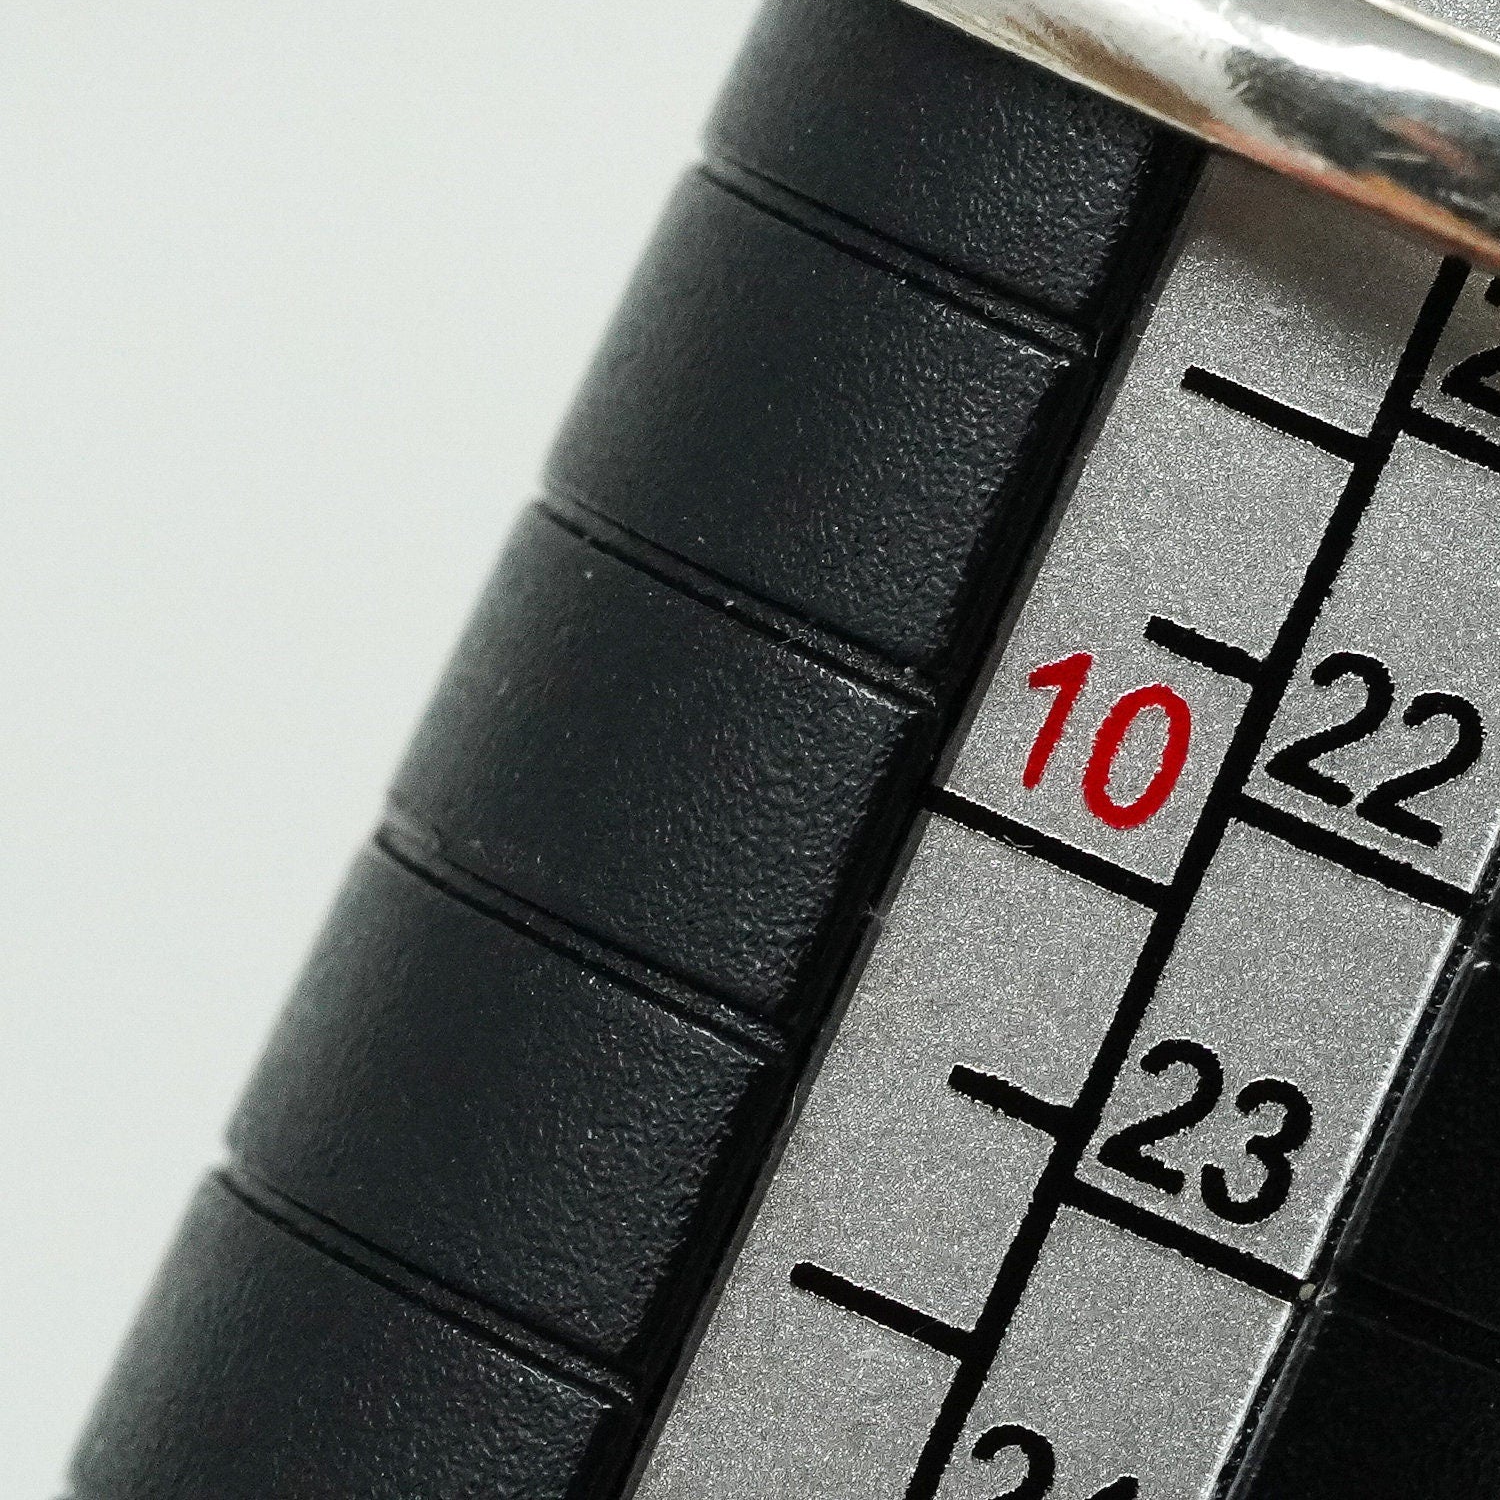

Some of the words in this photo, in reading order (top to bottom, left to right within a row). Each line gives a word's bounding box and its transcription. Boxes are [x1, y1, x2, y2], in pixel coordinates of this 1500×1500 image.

[1022, 652, 1193, 831] 10
[1264, 651, 1488, 849] 22
[1096, 1039, 1314, 1225] 23
